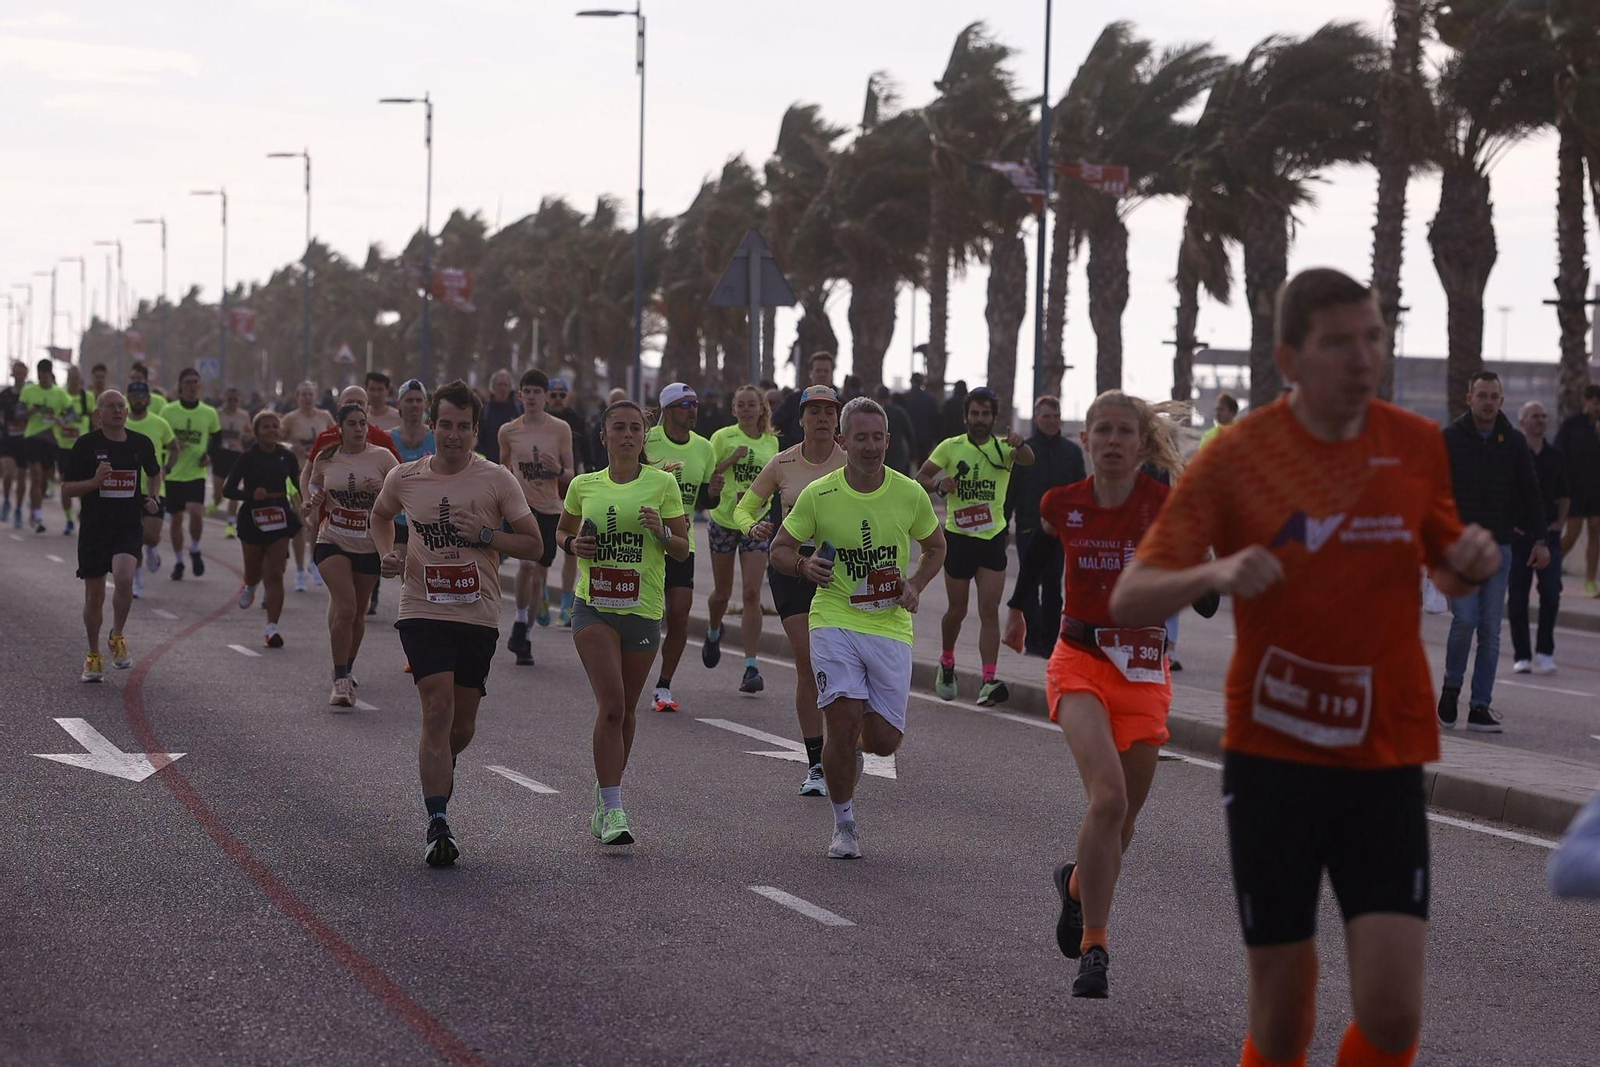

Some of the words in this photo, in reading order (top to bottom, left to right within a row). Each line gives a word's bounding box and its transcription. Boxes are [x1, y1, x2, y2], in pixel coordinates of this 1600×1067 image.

[518, 461, 543, 471] BRUN
[348, 518, 366, 527] 1323
[411, 520, 459, 536] BRUN
[422, 532, 458, 552] RUN
[595, 531, 644, 548] RUNCH
[617, 553, 642, 564] 2025
[836, 545, 898, 566] BRUNCH
[1078, 554, 1121, 570] MÁLAGA
[454, 577, 475, 589] 489
[615, 582, 635, 592] 488
[878, 580, 897, 593] 487
[1139, 646, 1159, 662] 309
[1318, 692, 1359, 718] 119
